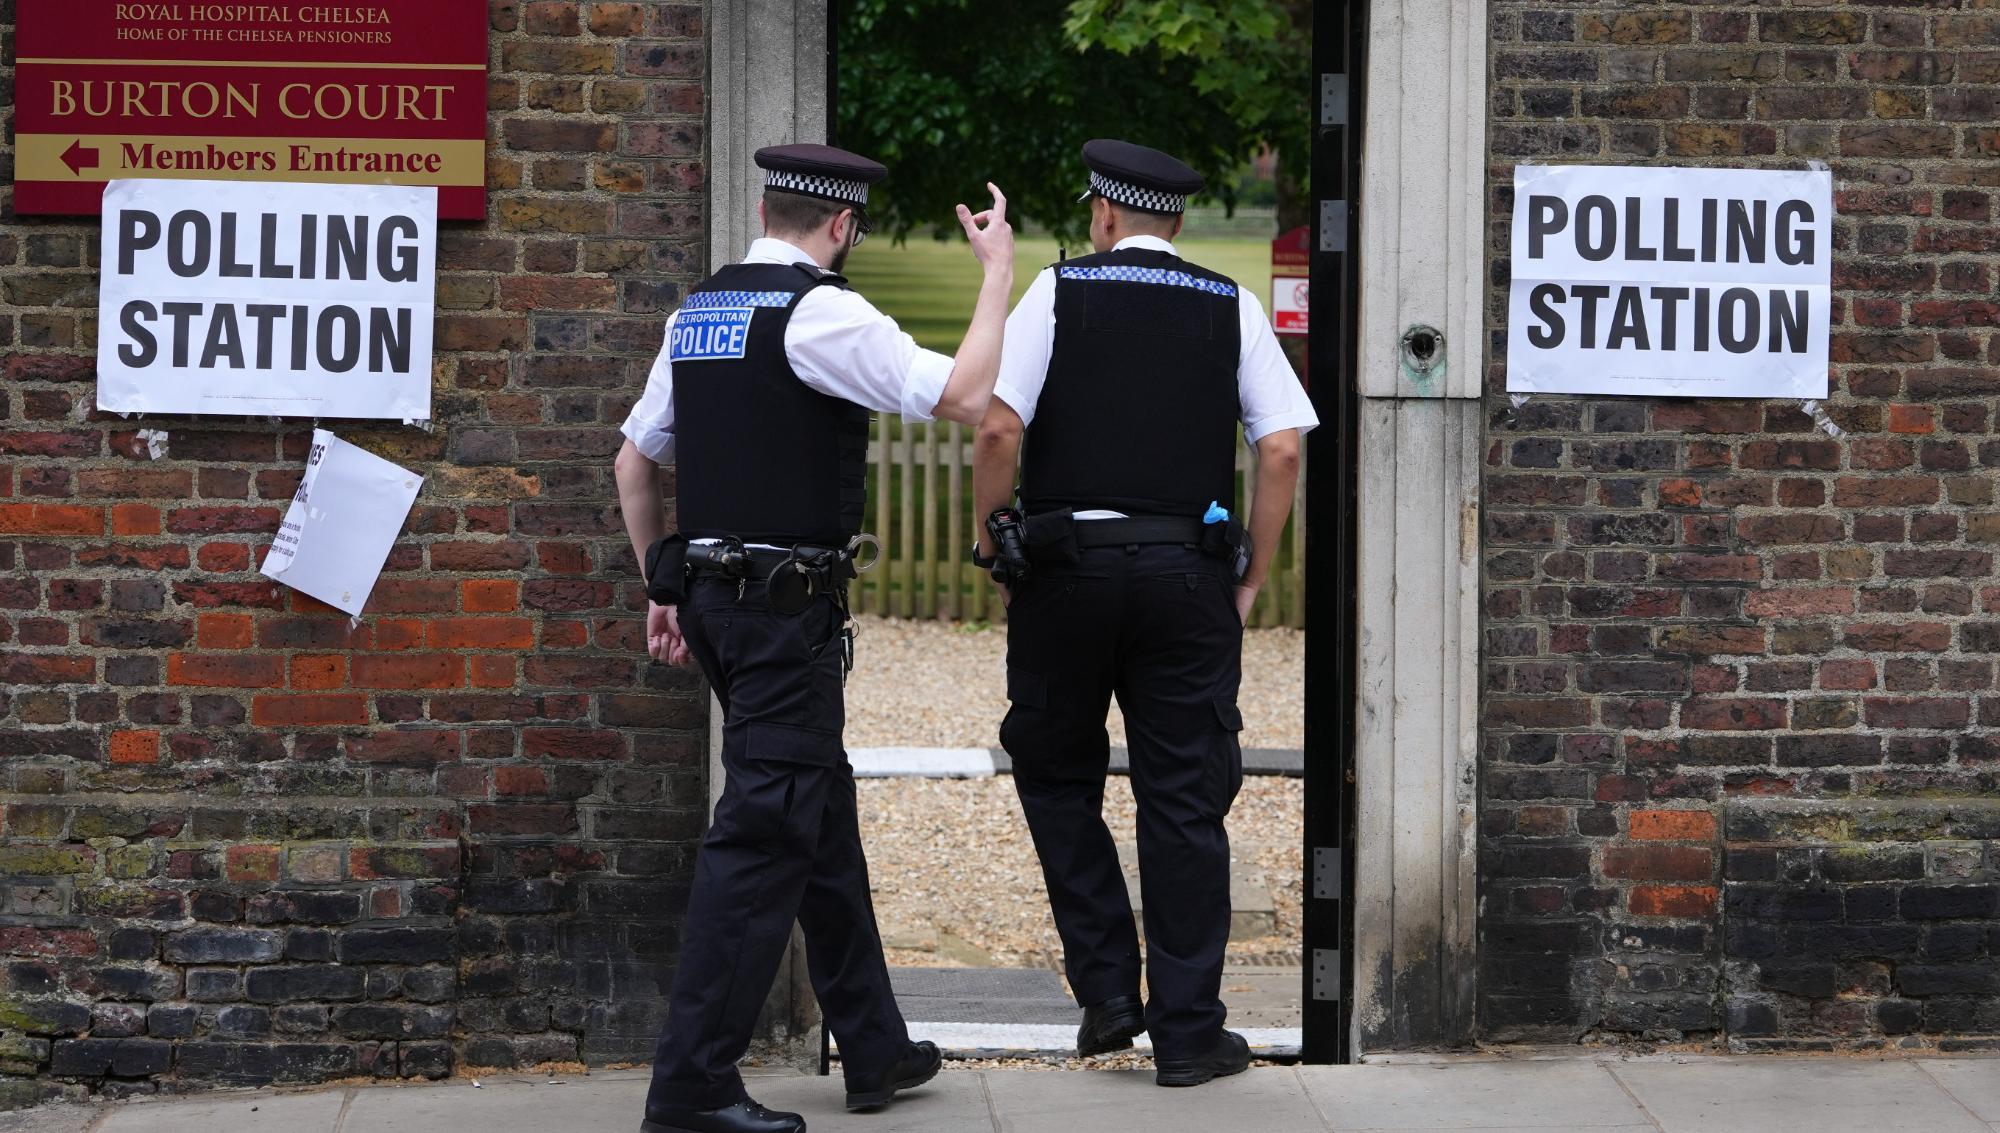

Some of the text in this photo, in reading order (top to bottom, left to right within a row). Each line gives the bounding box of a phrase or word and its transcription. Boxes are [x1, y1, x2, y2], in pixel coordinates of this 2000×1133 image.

[115, 4, 391, 24] ROYAL HOSPITAL CHELSEA
[117, 28, 392, 44] HOME OF THE CHELSEA PENSIONERS
[49, 80, 455, 121] BURTON COURT
[121, 143, 442, 173] Members Entrance
[118, 209, 419, 283] POLLING
[1528, 194, 1815, 266] POLLING
[676, 312, 747, 324] METROPOLITAN
[1527, 282, 1810, 354] STATION
[117, 299, 412, 374] STATION
[671, 325, 744, 355] POLICE
